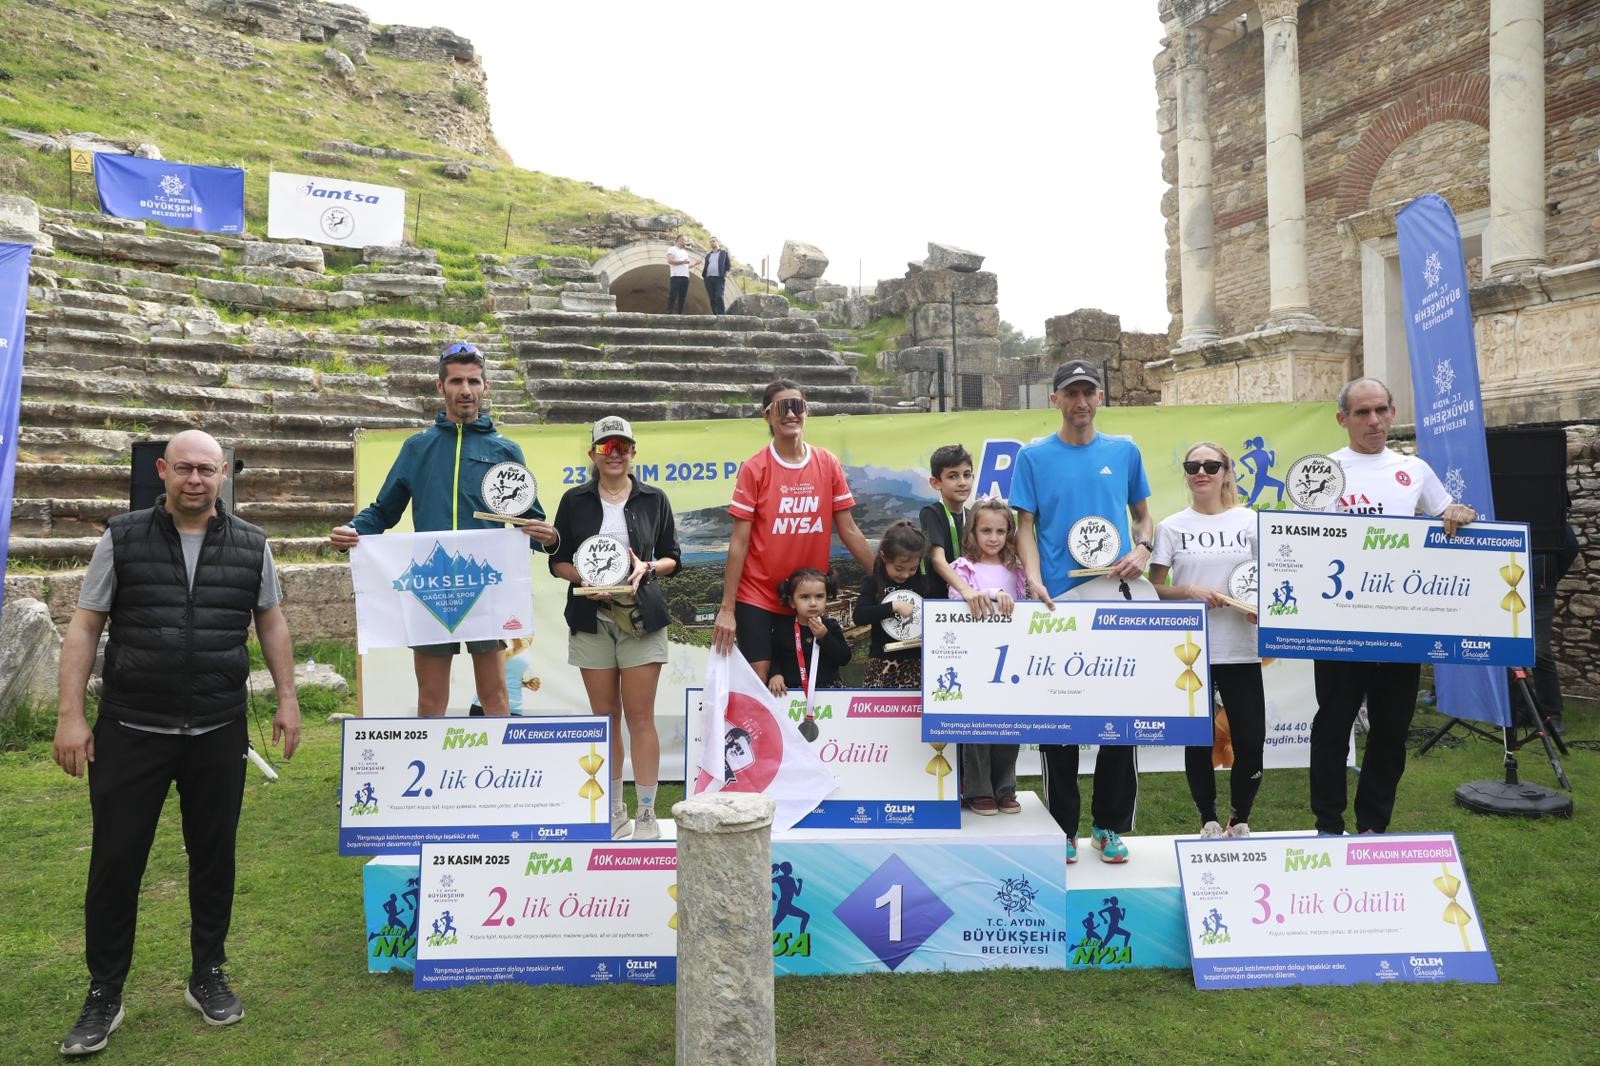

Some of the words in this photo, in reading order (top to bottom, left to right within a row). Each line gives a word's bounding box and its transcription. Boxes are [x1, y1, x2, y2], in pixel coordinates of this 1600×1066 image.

[306, 182, 380, 205] jantsa
[139, 200, 203, 213] BÜYÜKŞEHİR
[151, 209, 193, 218] BELEDİYESİ
[562, 466, 587, 484] 23
[665, 462, 718, 481] 2025
[1301, 464, 1332, 474] NYSA
[497, 470, 526, 482] NYSA
[778, 496, 820, 514] RUN
[771, 516, 824, 535] NYSA
[1080, 524, 1107, 535] NYSA
[1271, 525, 1283, 535] 23
[1285, 525, 1320, 536] KASIM
[1322, 528, 1348, 538] 2025
[1366, 526, 1386, 535] Run
[1362, 533, 1409, 551] NYSA
[1429, 532, 1448, 544] 10K
[1449, 536, 1475, 546] ERKEK
[1476, 537, 1523, 548] KATEGORİSİ
[588, 543, 617, 552] NYSA
[398, 572, 498, 591] YÜKSELİŞ
[1321, 559, 1354, 600] 3.
[1360, 571, 1395, 594] lük
[1402, 569, 1471, 596] Ödülü
[456, 591, 476, 599] SPOR
[435, 598, 464, 607] KULÜBÜ
[935, 613, 947, 623] 23
[987, 613, 1013, 623] 2025
[1097, 614, 1117, 626] 10K
[1118, 616, 1147, 626] ERKEK
[1149, 615, 1199, 626] KATEGORİSİ
[1027, 615, 1077, 635] NYSA
[1461, 638, 1491, 649] ÖZLEM
[986, 644, 1021, 685] 1.
[1027, 655, 1056, 677] lik
[1064, 652, 1136, 677] Ödülü
[788, 705, 832, 721] NSA
[852, 702, 872, 713] 10K
[873, 703, 900, 713] KADIN
[1133, 719, 1165, 730] ÖZLEM
[1273, 723, 1292, 732] 444
[1294, 722, 1308, 731] 40
[354, 731, 367, 740] 23
[368, 730, 401, 740] KASIM
[404, 730, 428, 740] 2025
[446, 727, 465, 735] Run
[508, 728, 526, 739] 10K
[528, 730, 554, 739] ERKEK
[556, 728, 604, 739] KATEGORİSİ
[442, 732, 488, 750] NYSA
[819, 739, 889, 763] Ödülü
[401, 760, 433, 797] 2.
[440, 769, 468, 789] lik
[475, 765, 543, 789] Ödülü
[884, 803, 915, 813] ÖZLEM
[538, 827, 568, 837] ÖZLEM
[528, 852, 549, 861] Run
[1190, 854, 1203, 864] 23
[1204, 853, 1240, 863] KASIM
[1242, 852, 1267, 862] 2025
[1286, 848, 1304, 857] Run
[1350, 848, 1371, 860] 10K
[1372, 850, 1399, 860] KADIN
[1401, 847, 1452, 858] KATEGORİSİ
[432, 856, 445, 865] 23
[447, 855, 483, 865] KASIM
[485, 855, 510, 865] 2025
[593, 854, 614, 866] 10K
[614, 856, 641, 866] KADIN
[1284, 852, 1332, 873] NYSA
[524, 857, 573, 877] NYSA
[481, 886, 515, 927] 2.
[522, 896, 551, 918] lik
[559, 892, 630, 918] Ödülü
[1251, 883, 1285, 925] 3.
[1290, 893, 1325, 915] lük
[1333, 888, 1406, 914] Ödülü
[875, 884, 904, 942] 1
[986, 918, 1007, 927] T.C.
[1010, 918, 1045, 927] AYDIN
[963, 929, 1067, 944] BÜYÜKŞEHİR
[981, 944, 1049, 955] BELEDİYESİ
[1071, 945, 1132, 965] NYSA
[626, 959, 657, 969] ÖZLEM
[1409, 956, 1444, 967] ÖZLEM
